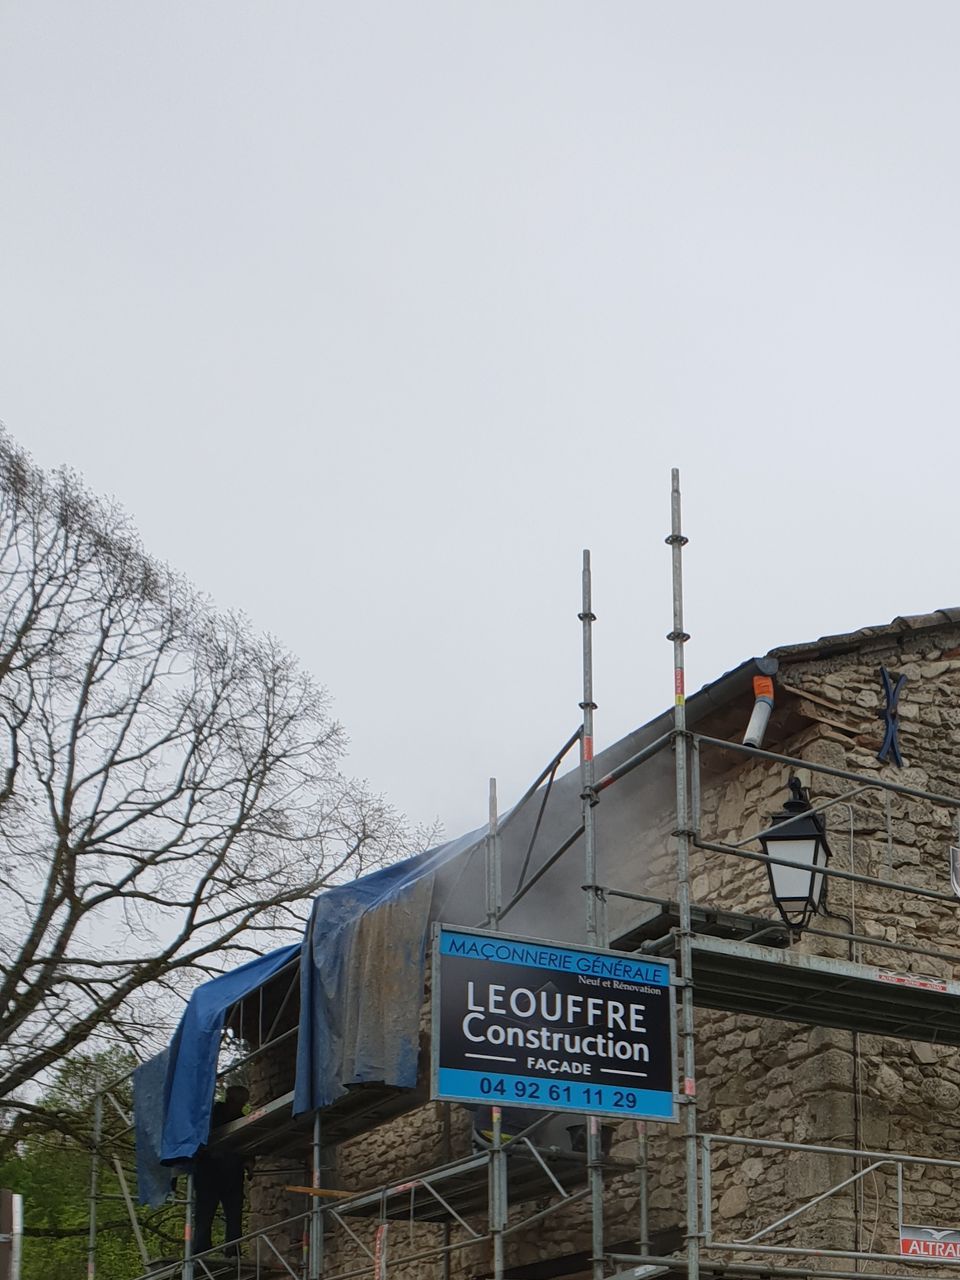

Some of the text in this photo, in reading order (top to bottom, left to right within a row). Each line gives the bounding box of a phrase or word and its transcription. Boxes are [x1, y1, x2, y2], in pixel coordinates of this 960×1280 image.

[449, 938, 662, 983] MAÇONNERIE GÉNÉRALE
[578, 975, 661, 995] Neuf et Rénovation
[467, 981, 647, 1033] LEOUFFRE
[462, 1012, 650, 1063] Construction
[527, 1056, 592, 1076] FAÇADE
[480, 1077, 637, 1108] 04 92 61 11 29
